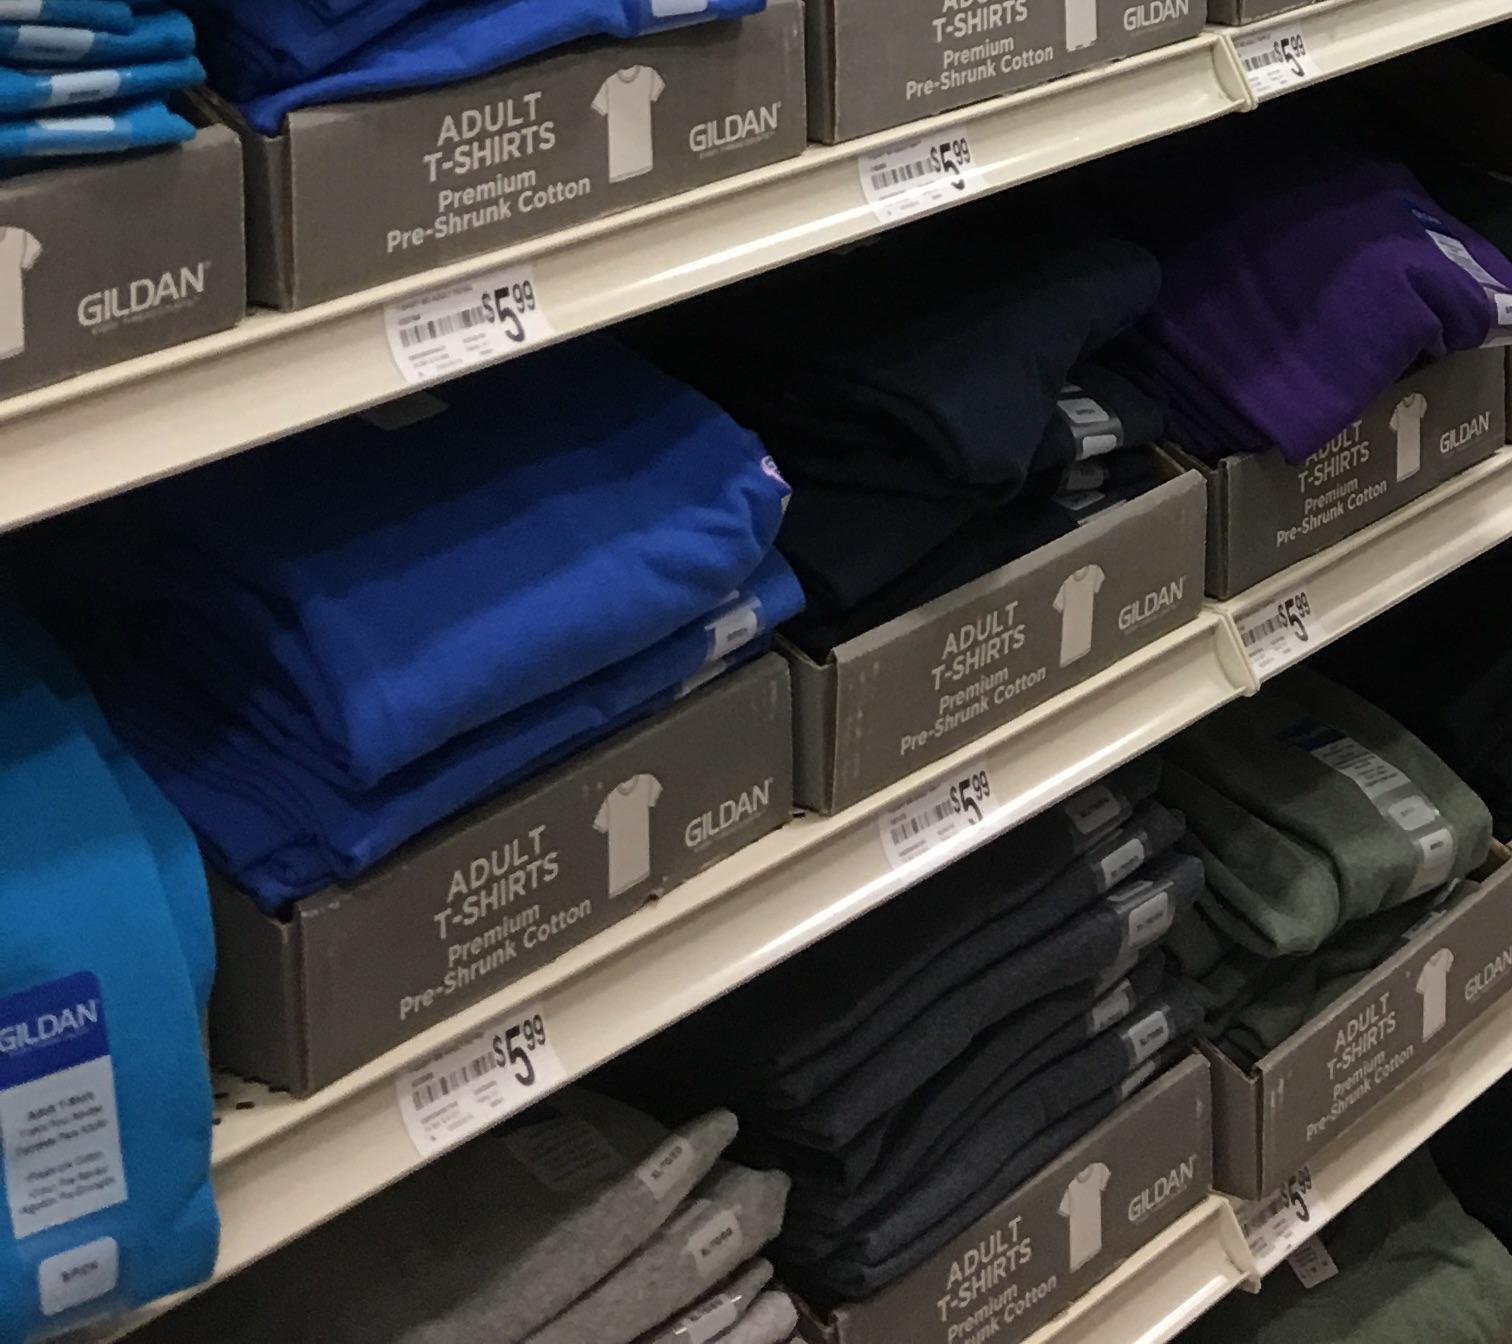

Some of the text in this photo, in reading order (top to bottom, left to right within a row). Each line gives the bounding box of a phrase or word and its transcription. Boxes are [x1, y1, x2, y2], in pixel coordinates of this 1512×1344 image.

[905, 43, 1055, 102] Pre-Shrunk Cotton
[942, 33, 1015, 71] Premium
[436, 90, 545, 149] ADULT
[687, 100, 783, 156] GILDAN
[422, 120, 557, 185] T-SHIRTS
[385, 175, 592, 255] Pre-Shrunk Cotton
[436, 166, 538, 217] Premium
[76, 260, 211, 330] GILDAN
[1438, 410, 1491, 456] GILDAN
[1297, 440, 1371, 494] T-SHIRTS
[1303, 477, 1359, 515] Premium
[940, 600, 1020, 663] ADULT
[1116, 575, 1187, 633] GILDAN
[930, 623, 1027, 693] T-SHIRTS
[899, 665, 1048, 757] Pre-Shrunk Cotton
[938, 664, 1010, 717] Premium
[683, 775, 775, 850] GILDAN
[434, 850, 561, 942] T-SHIRTS
[446, 823, 547, 907] ADULT
[399, 895, 593, 1021] Pre-Shrunk Cotton
[446, 900, 541, 969] Premium
[0, 999, 98, 1054] GILDAN
[1326, 1012, 1397, 1082] T-SHIRTS
[1333, 991, 1391, 1054] ADULT
[1333, 1049, 1387, 1100] Premium
[1127, 1154, 1199, 1223] GILDAN
[936, 1237, 1034, 1322] T-SHIRTS
[945, 1214, 1023, 1291] ADULT
[947, 1282, 1019, 1344] Premium
[1003, 1275, 1058, 1324] Cotton
